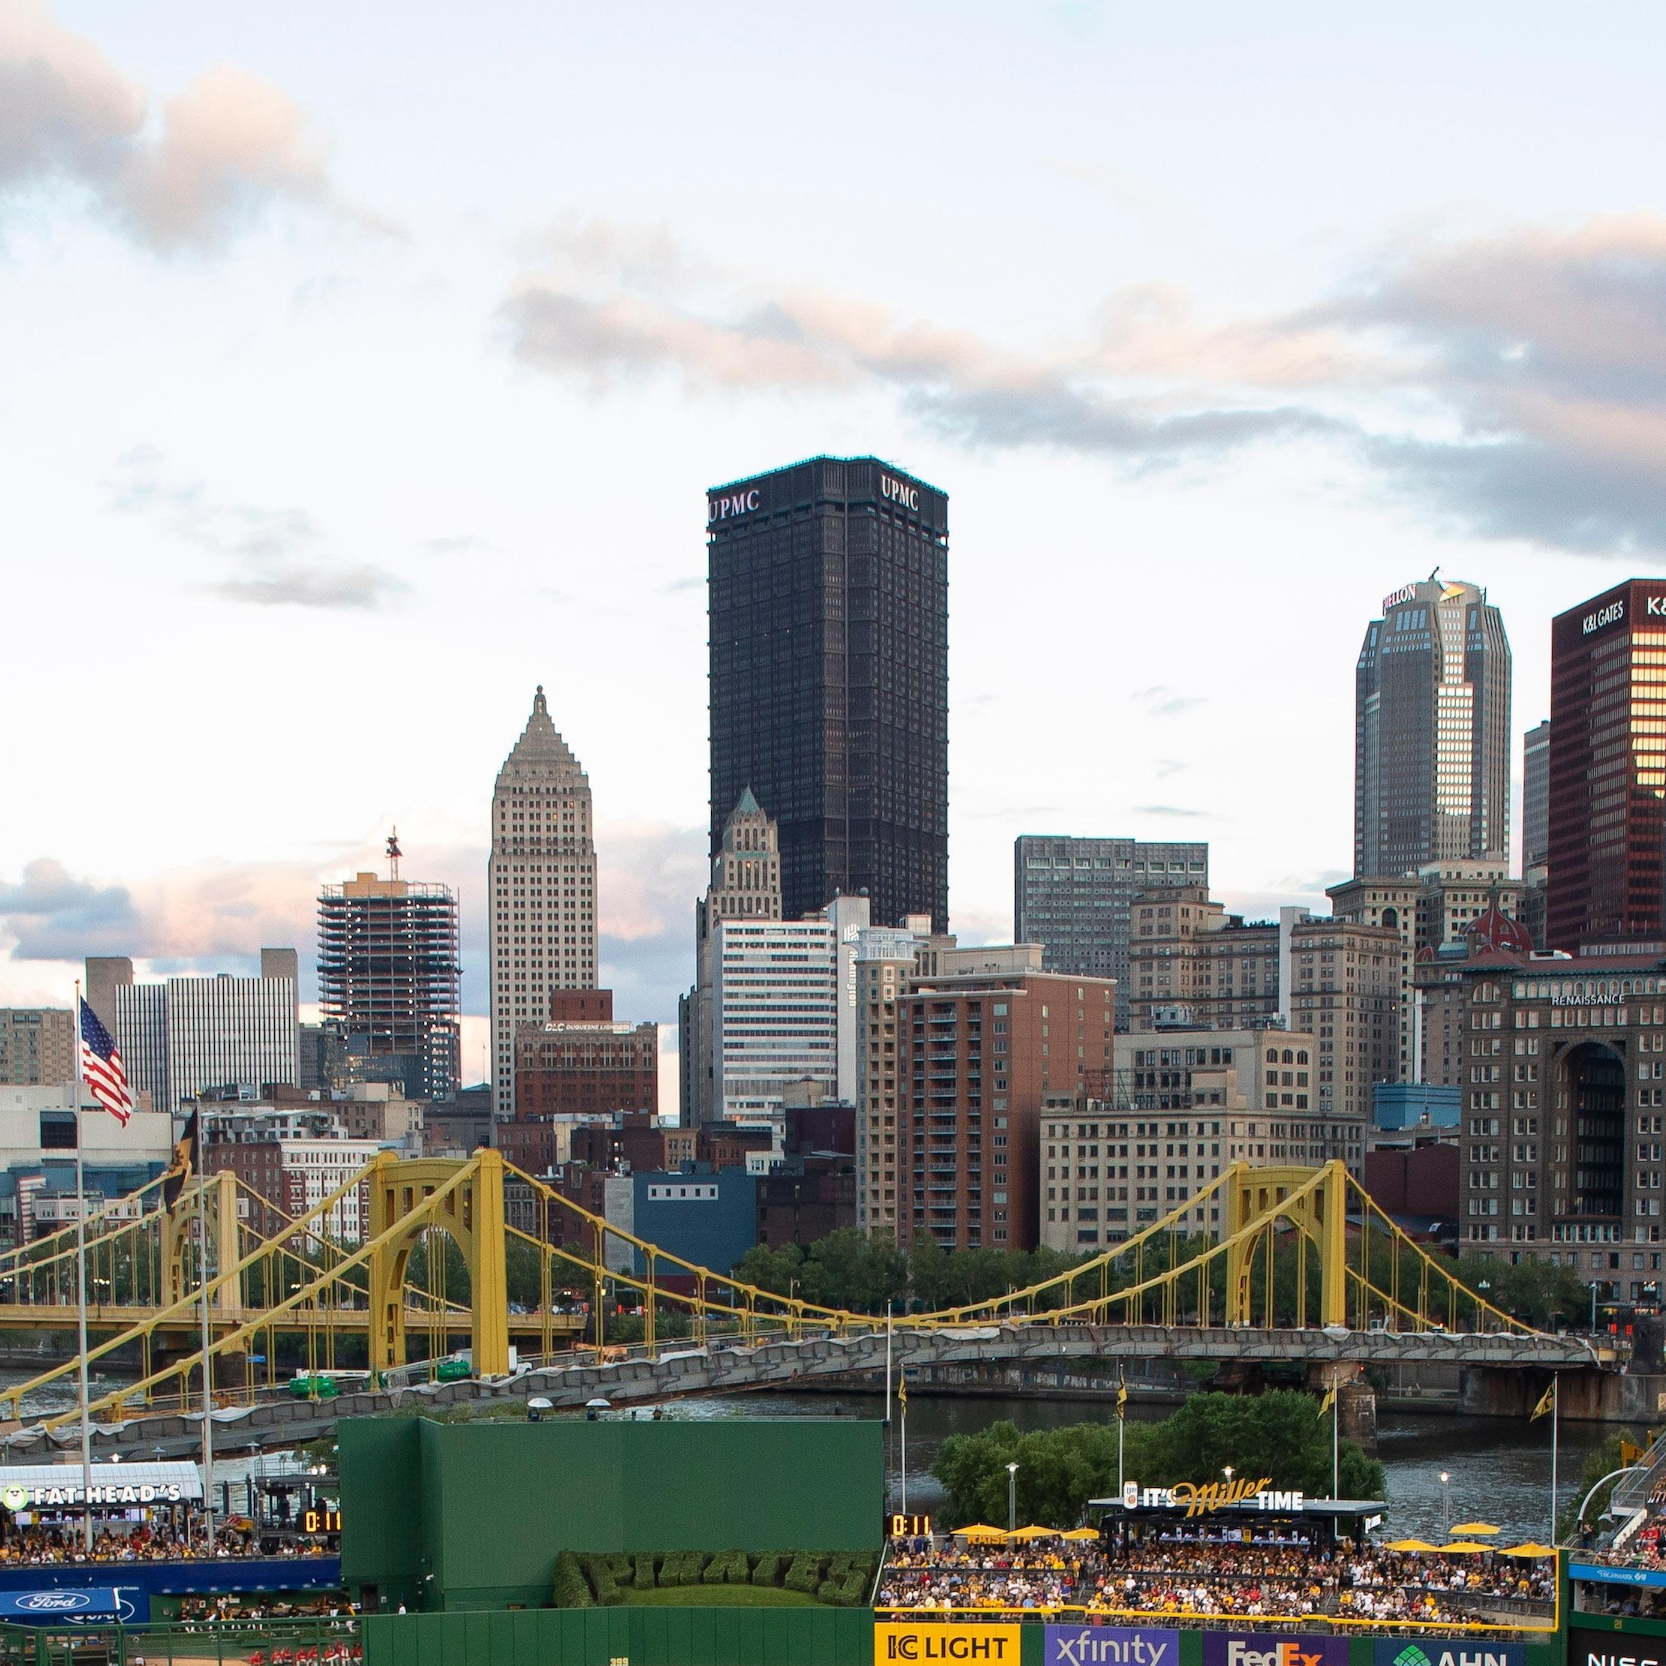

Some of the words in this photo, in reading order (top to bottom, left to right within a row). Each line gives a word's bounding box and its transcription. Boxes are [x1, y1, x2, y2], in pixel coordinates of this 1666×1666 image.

[708, 489, 760, 523] UPMC
[881, 475, 919, 512] UPMC
[1582, 615, 1598, 635] K&L
[1598, 601, 1624, 627] GATES
[1551, 994, 1625, 1006] RENAISSANCE
[34, 1487, 79, 1505] FAT
[86, 1483, 181, 1504] HEAD'S
[1143, 1488, 1177, 1507] IT'S
[1172, 1477, 1273, 1517] Miller
[1256, 1491, 1304, 1511] TIME
[305, 1511, 342, 1533] 0:11
[892, 1515, 930, 1536] 0:11
[587, 1550, 874, 1606] PIRATES
[28, 1593, 78, 1609] Ford
[888, 1635, 918, 1660] IC
[926, 1636, 1009, 1660] LIGHT
